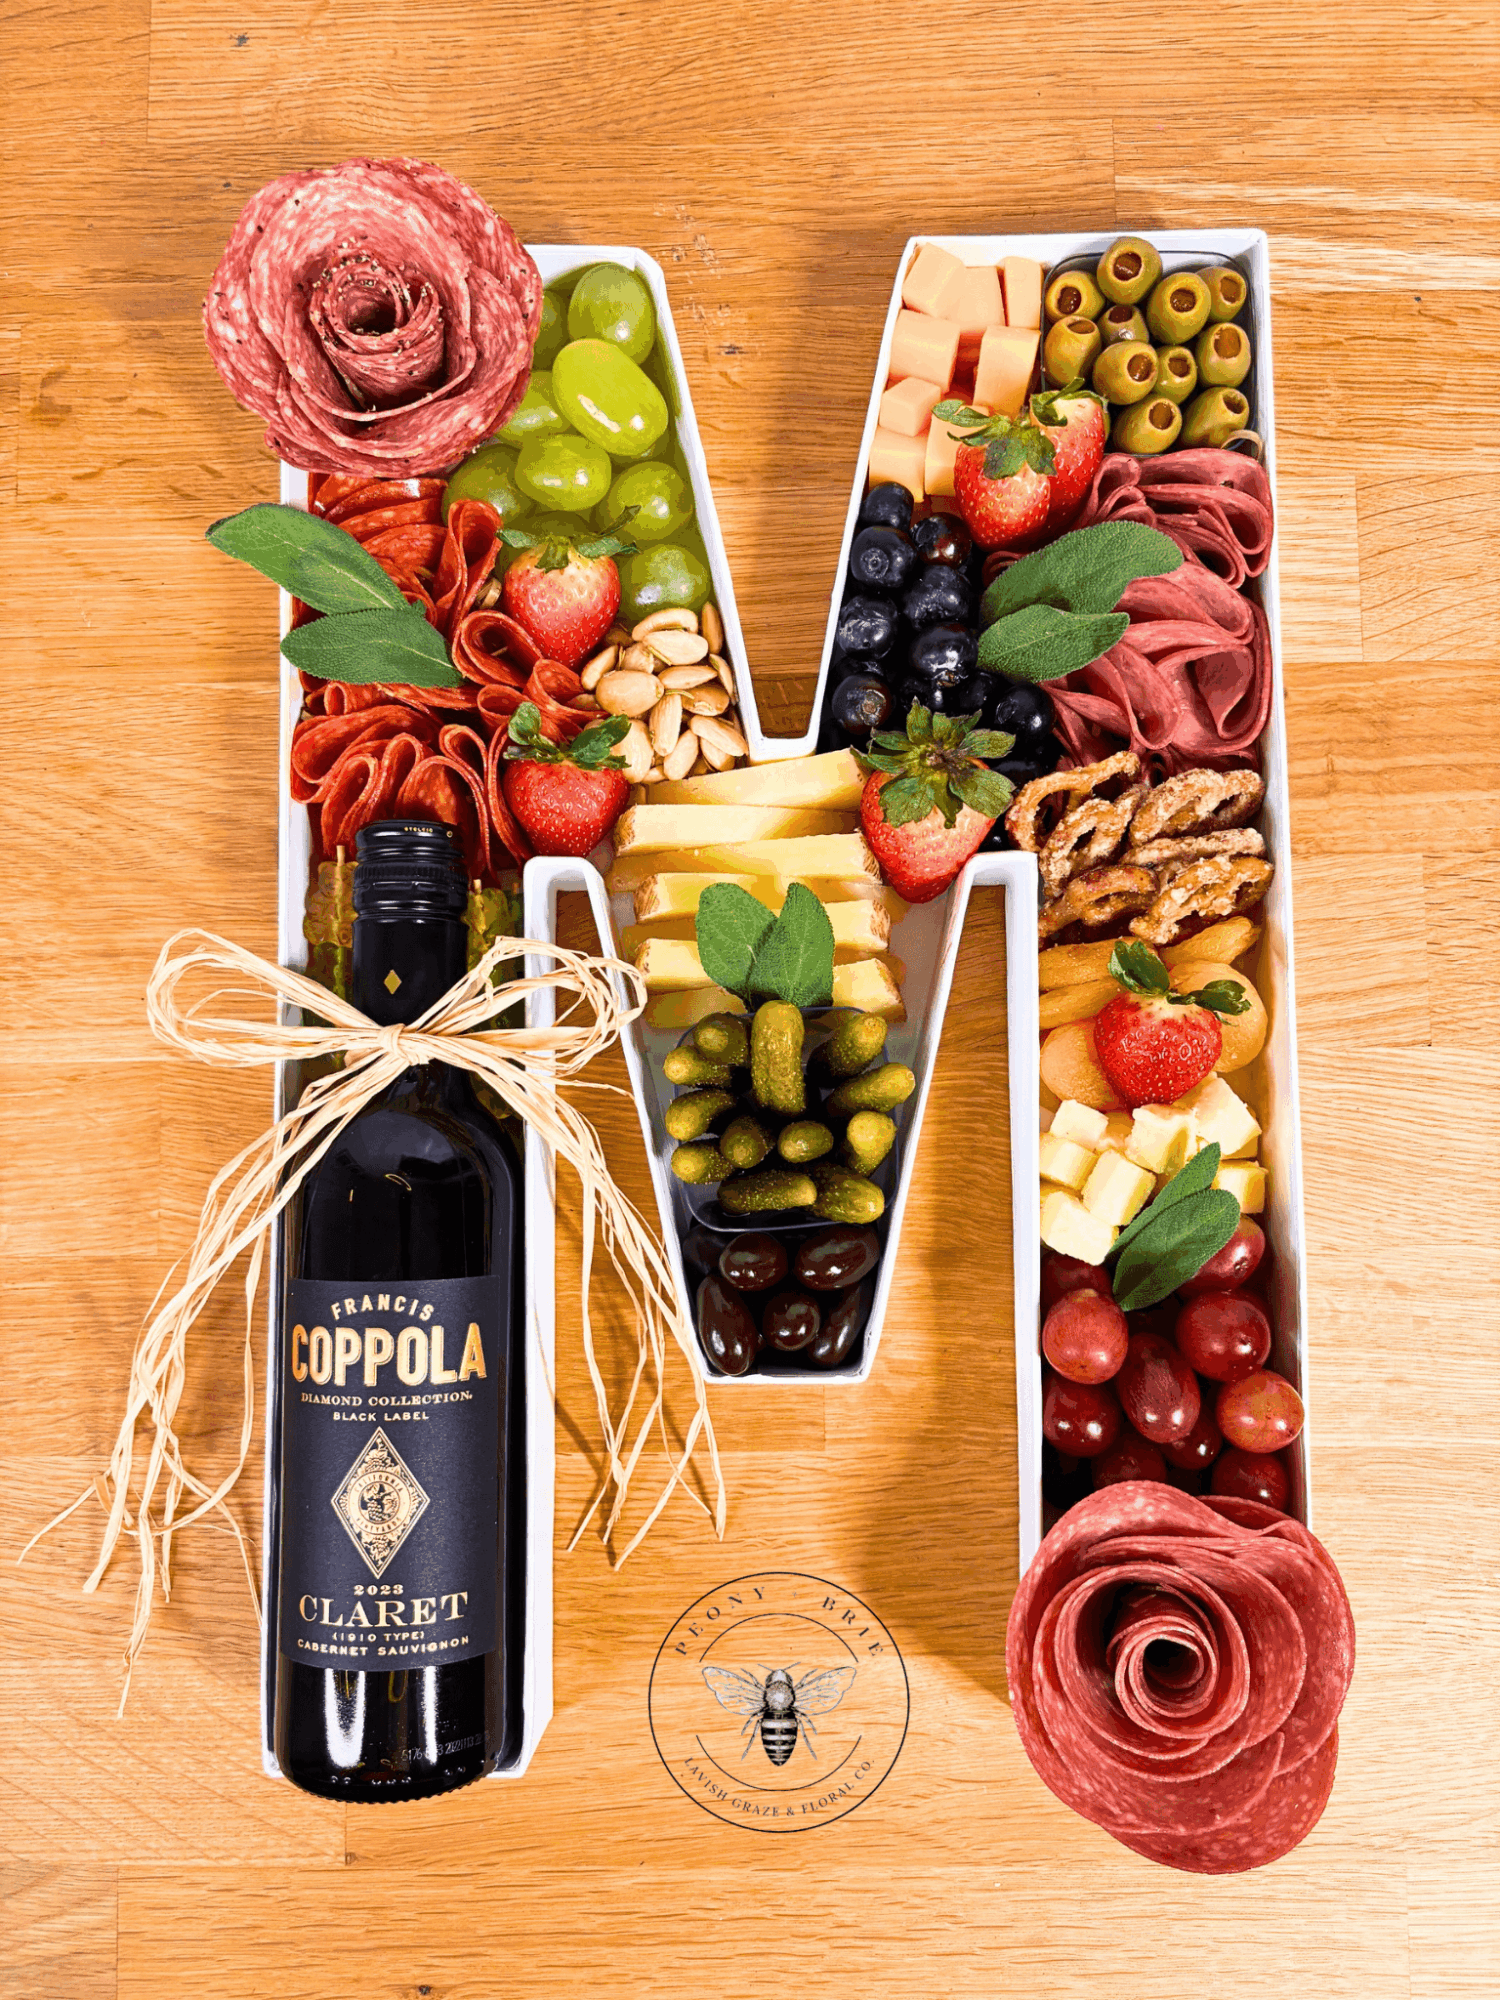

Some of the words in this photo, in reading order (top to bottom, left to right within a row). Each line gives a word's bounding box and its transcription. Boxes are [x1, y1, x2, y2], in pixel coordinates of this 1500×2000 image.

[330, 1293, 434, 1321] FRANCIS
[291, 1322, 487, 1387] COPPOLA
[301, 1392, 362, 1406] DIAMOND
[333, 1411, 377, 1421] BLACK
[384, 1411, 430, 1421] LABEL
[353, 1584, 404, 1596] 2023
[299, 1591, 469, 1628] CLARET
[383, 1631, 425, 1642] TYPE)
[297, 1638, 368, 1656] CABERNET
[377, 1635, 469, 1656] SAUVIGNON
